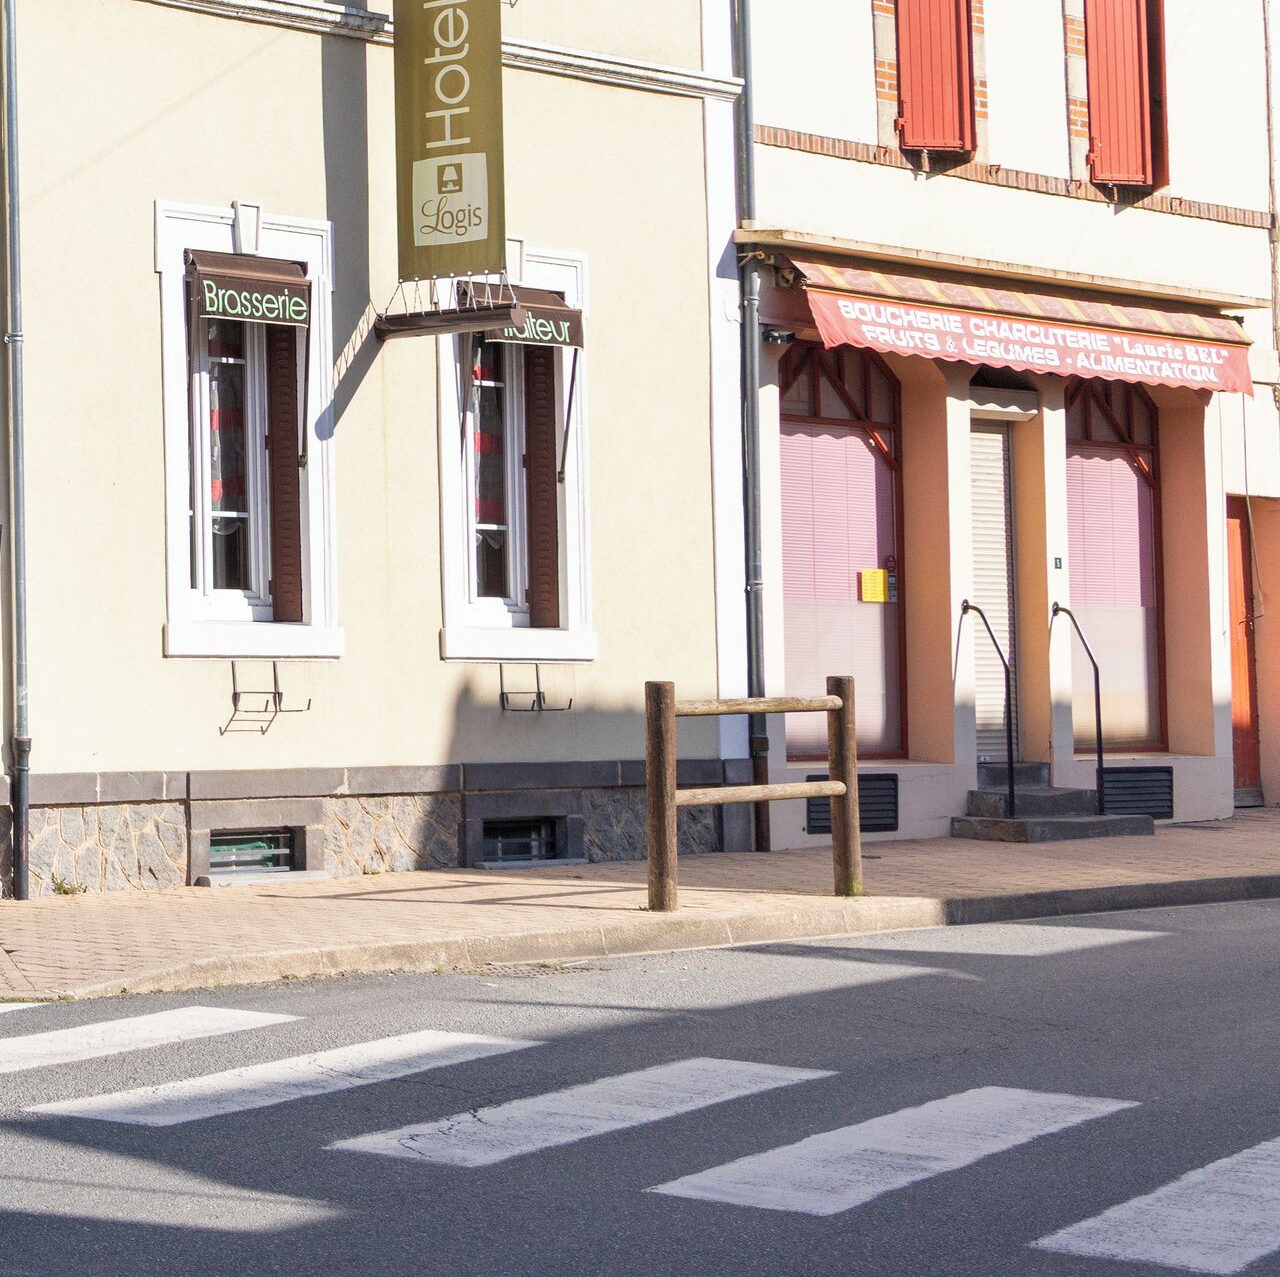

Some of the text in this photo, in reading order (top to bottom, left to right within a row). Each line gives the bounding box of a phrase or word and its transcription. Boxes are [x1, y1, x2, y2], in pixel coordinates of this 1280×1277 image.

[419, 195, 482, 236] Logis
[203, 279, 308, 321] Brasserie
[836, 299, 964, 334] BOUCHERIE
[969, 318, 1111, 352] CHARCUTERIE
[861, 324, 940, 352] FRUITS
[945, 335, 959, 353] &
[961, 337, 1060, 366] LEGUMES
[1077, 352, 1221, 382] ALIMENTATION
